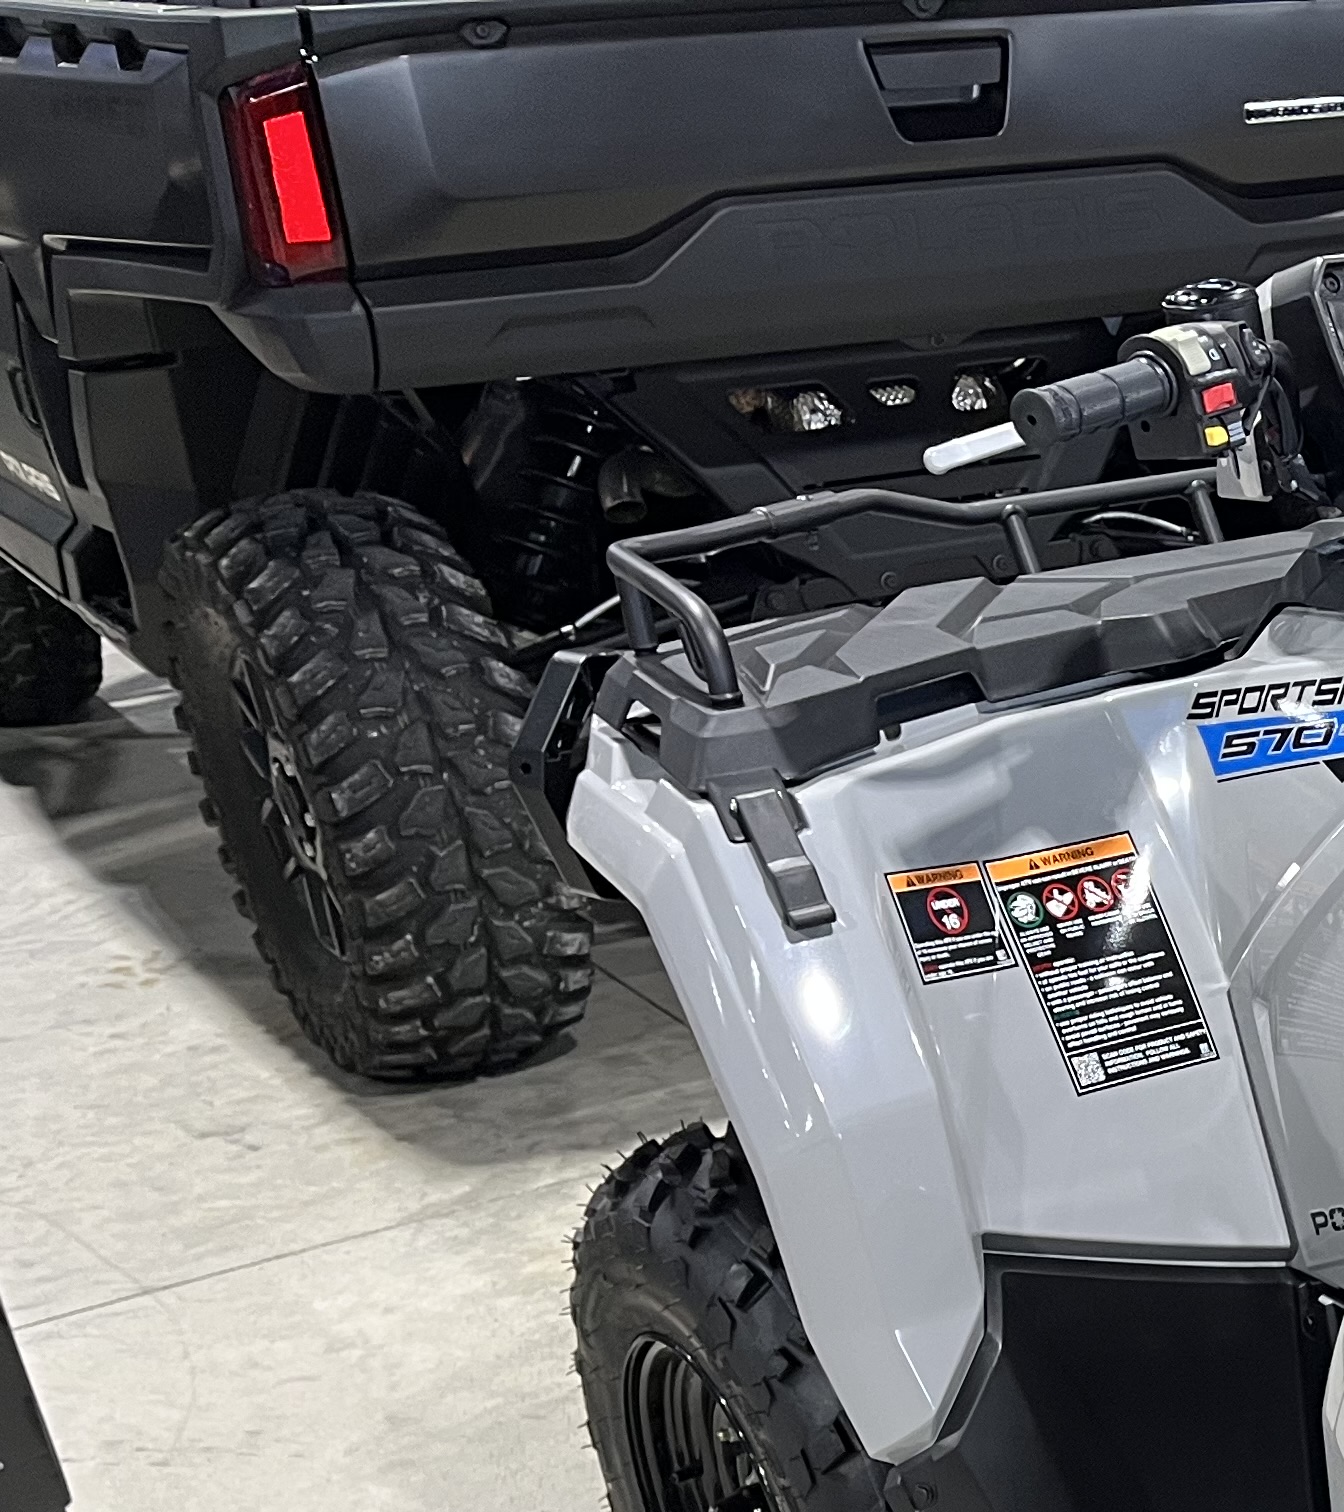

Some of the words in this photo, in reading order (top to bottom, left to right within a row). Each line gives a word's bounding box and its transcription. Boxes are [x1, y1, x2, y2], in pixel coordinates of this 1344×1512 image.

[1218, 717, 1339, 763] 570
[1039, 846, 1095, 867] WARNING
[915, 869, 964, 885] WARNING
[941, 914, 962, 931] 16
